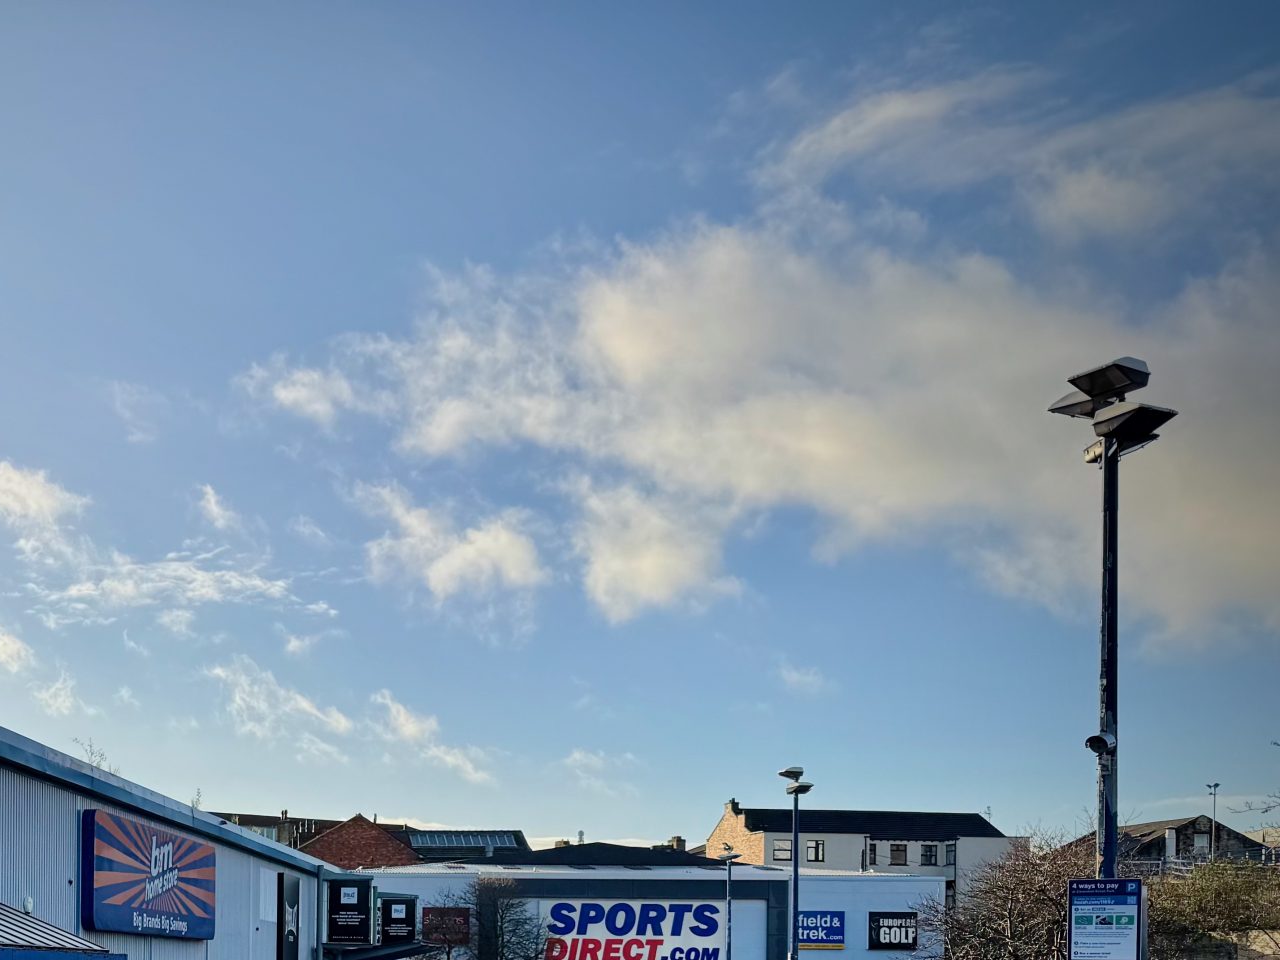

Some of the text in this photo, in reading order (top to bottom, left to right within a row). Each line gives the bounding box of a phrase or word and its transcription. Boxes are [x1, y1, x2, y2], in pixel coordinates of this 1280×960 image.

[145, 867, 179, 902] home store
[1128, 883, 1136, 891] P
[133, 911, 188, 935] Big Brands Big Savings
[547, 902, 720, 937] SPORTS
[798, 914, 841, 927] field &
[879, 927, 916, 944] GOLF
